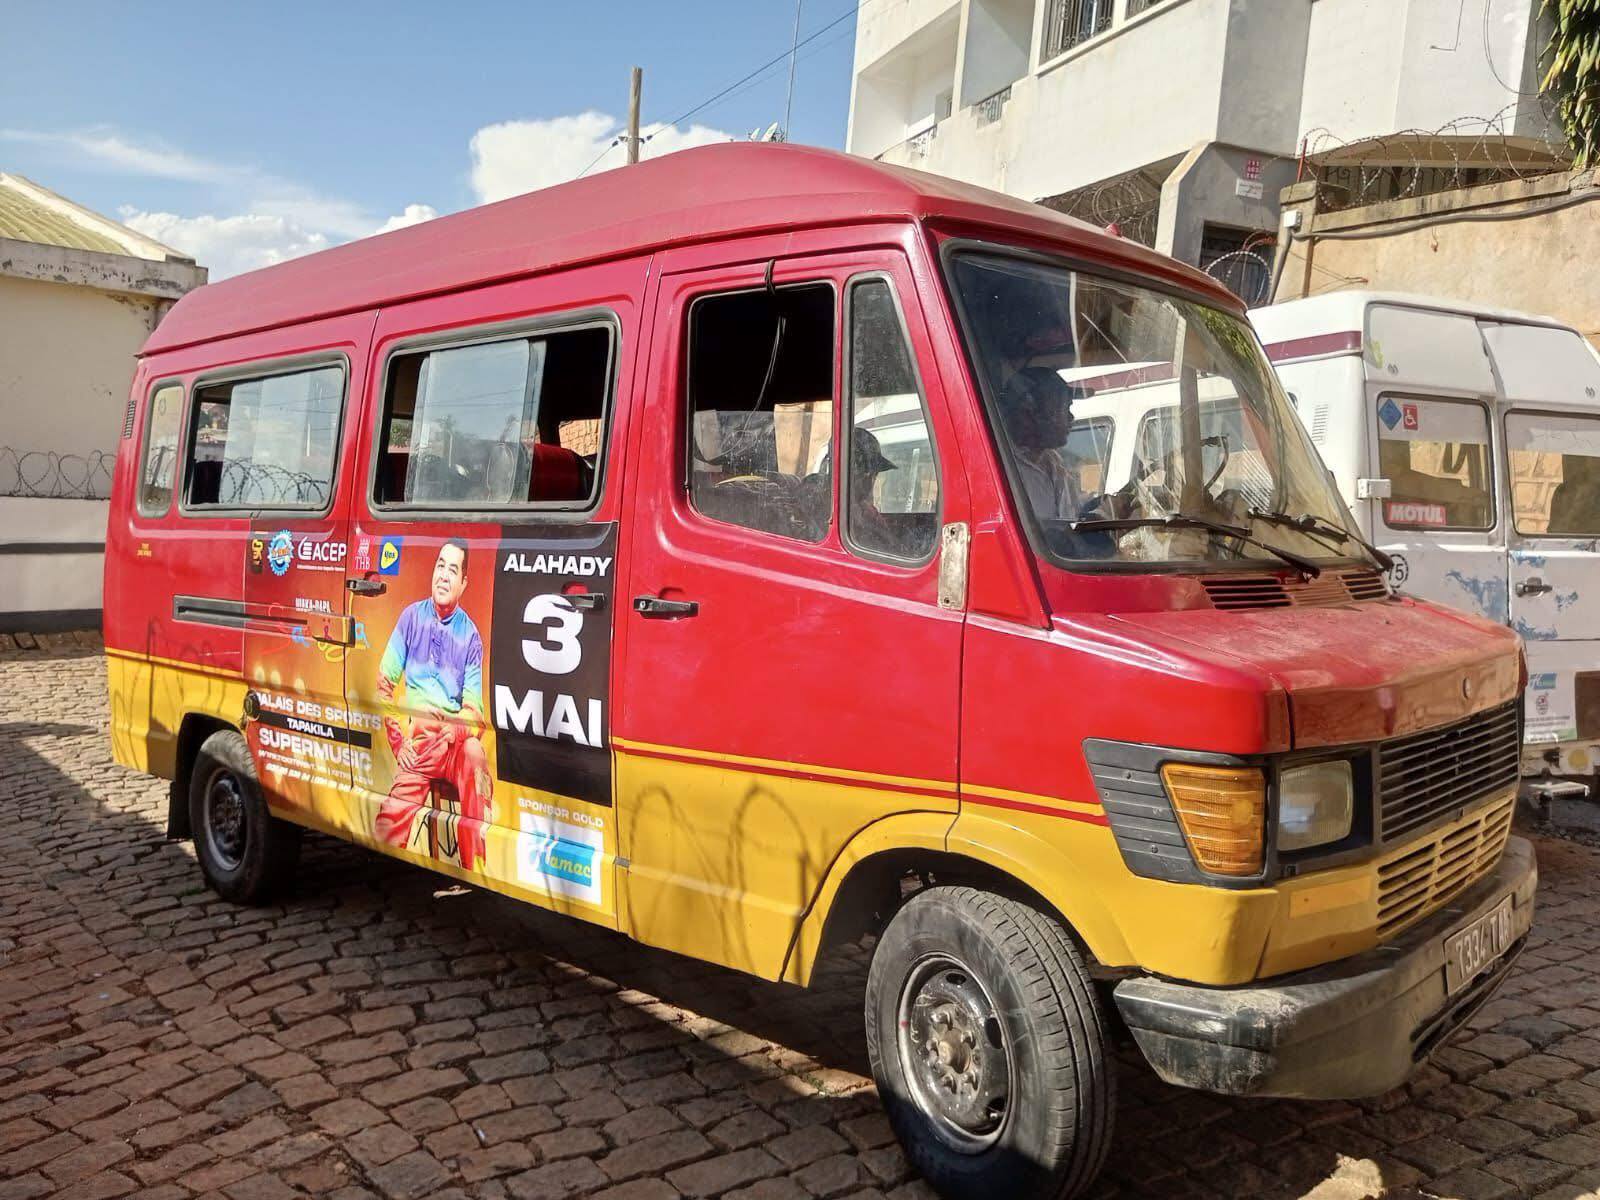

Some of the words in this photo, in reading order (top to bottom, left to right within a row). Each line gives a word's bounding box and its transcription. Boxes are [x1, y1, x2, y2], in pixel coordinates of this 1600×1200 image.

[1391, 504, 1442, 522] MOTUL
[312, 541, 347, 562] ACEP
[355, 556, 370, 570] THB
[503, 553, 612, 577] ALAHADY
[521, 594, 584, 674] 3
[296, 700, 322, 718] DES
[325, 707, 382, 729] SPORTS
[495, 684, 603, 748] MAI
[287, 717, 335, 739] TAPAKILA
[259, 728, 373, 770] SUPERMUSIC
[518, 797, 570, 818] SPONSOR
[1455, 923, 1486, 980] 7334
